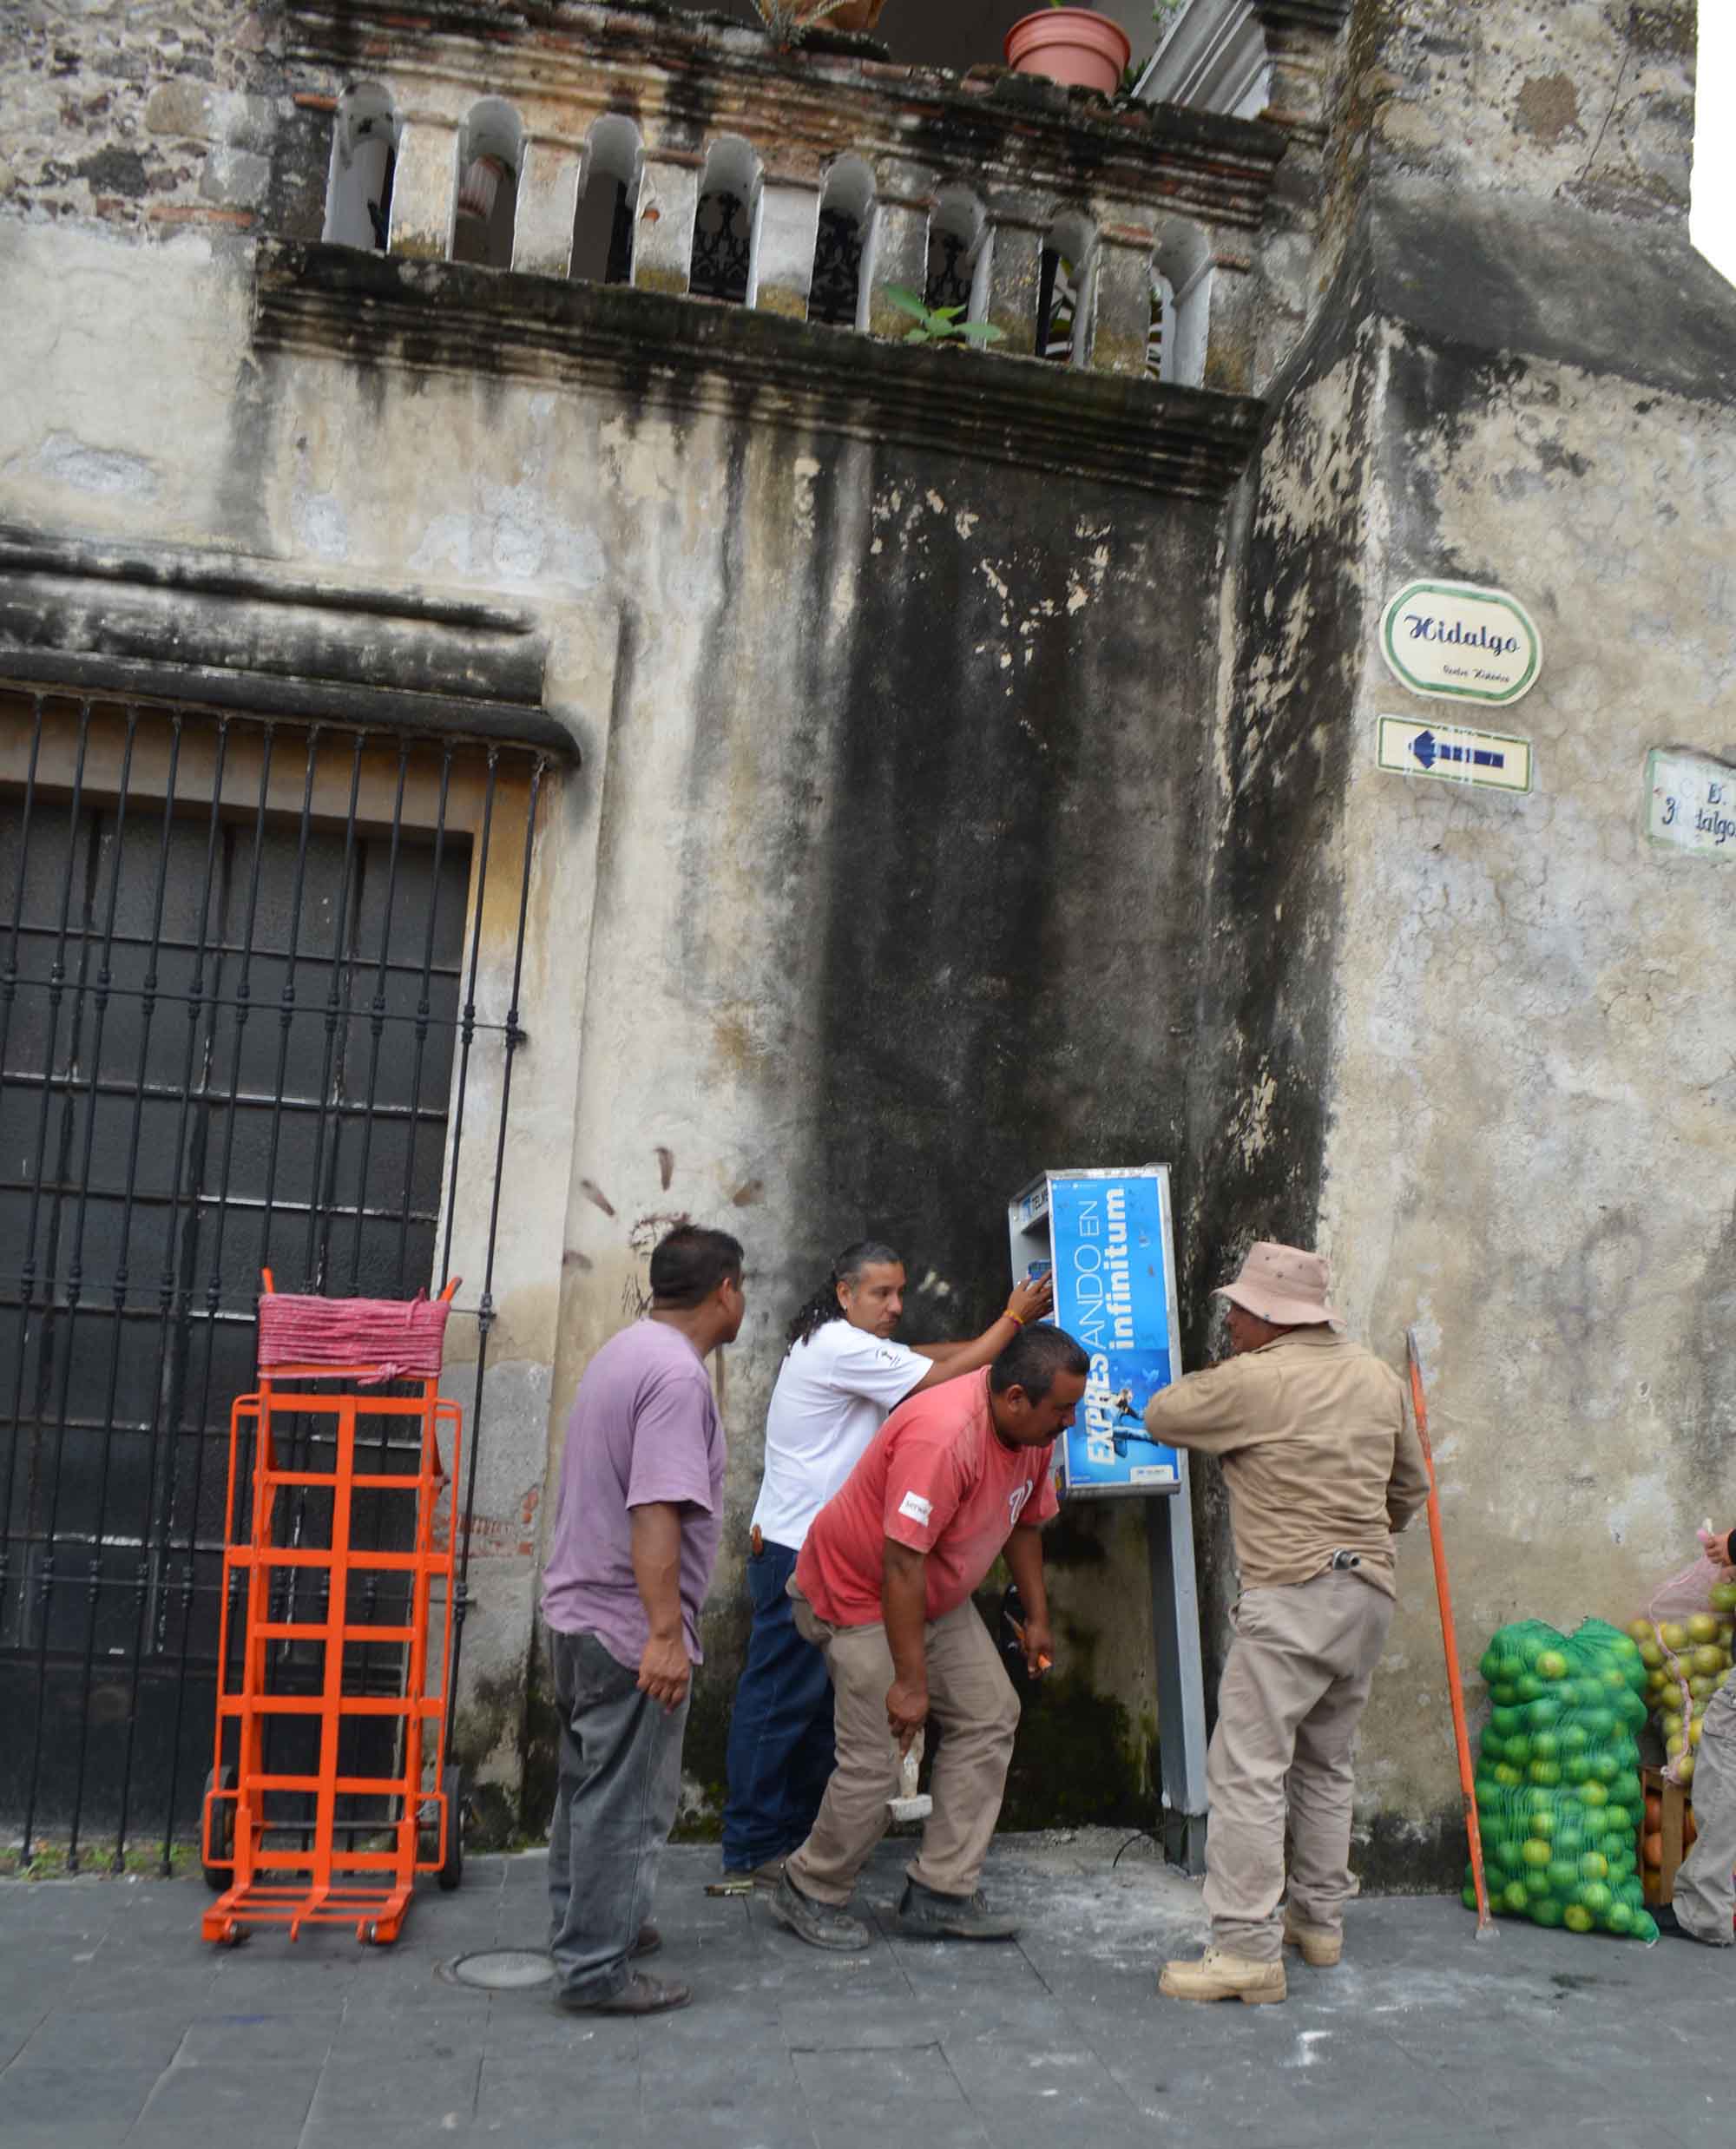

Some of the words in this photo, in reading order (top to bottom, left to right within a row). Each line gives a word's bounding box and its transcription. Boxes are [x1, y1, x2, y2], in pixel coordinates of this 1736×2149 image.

[1404, 614, 1520, 657] Hidalgo
[1078, 1200, 1100, 1237] EN
[1103, 1187, 1135, 1351] infinitum
